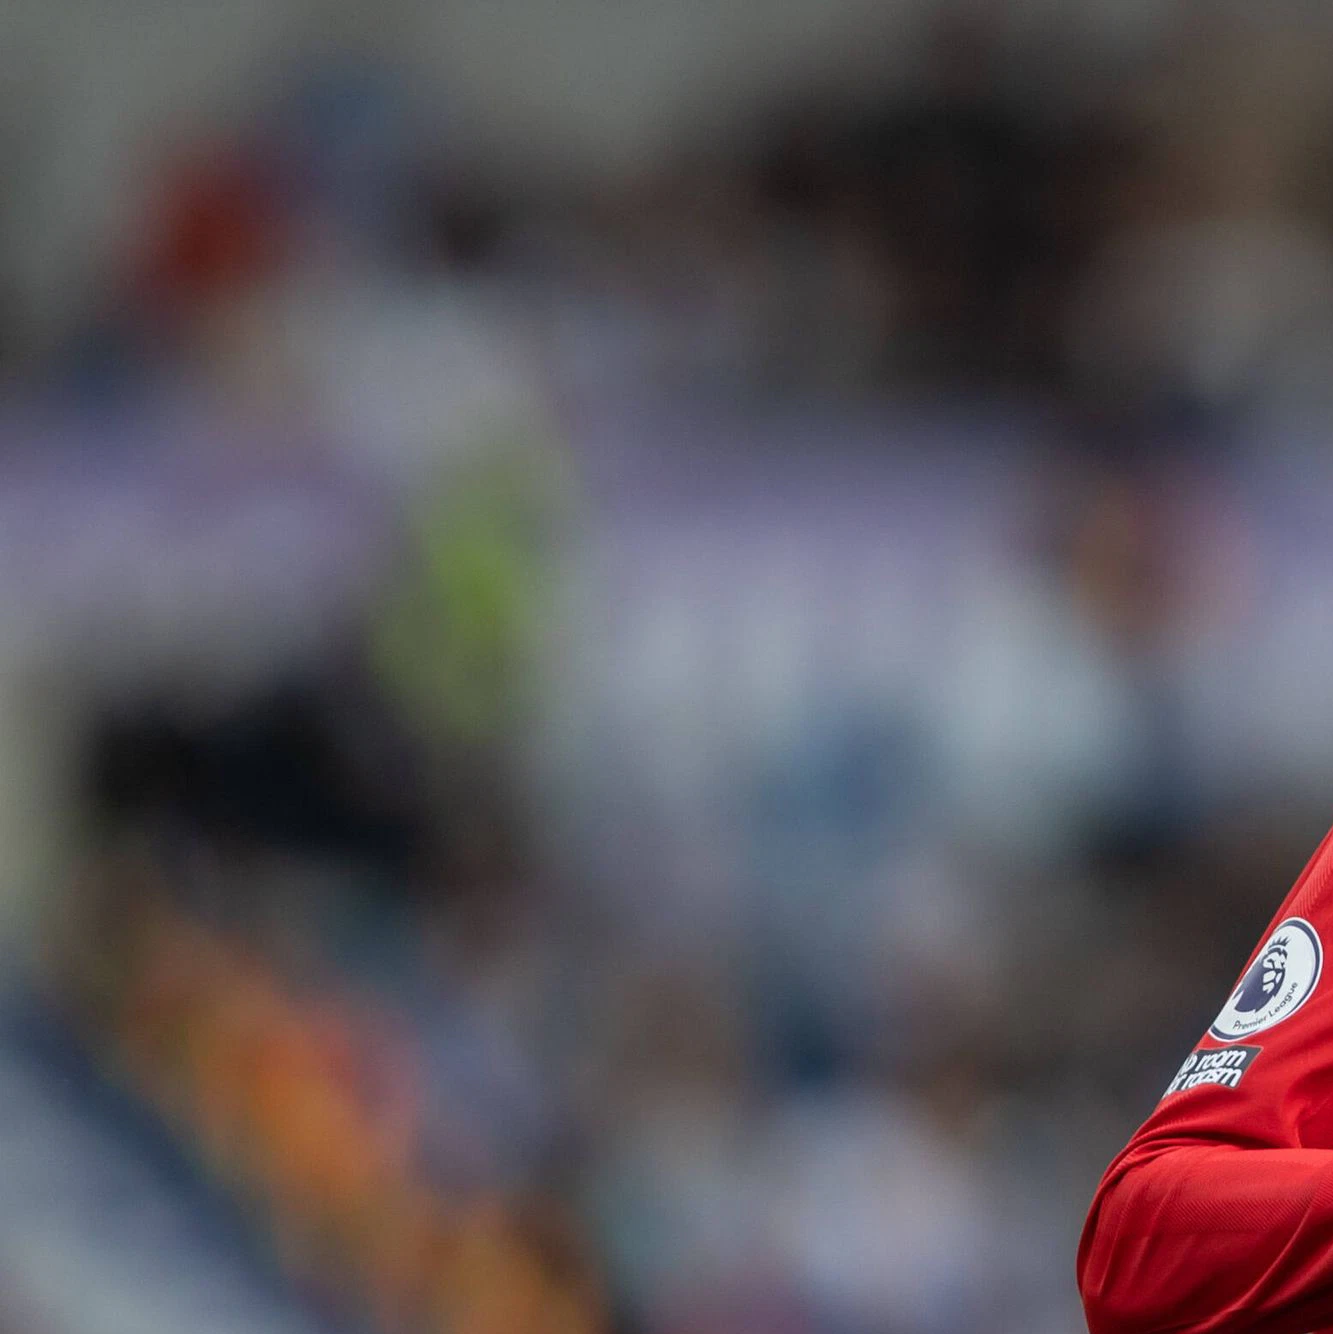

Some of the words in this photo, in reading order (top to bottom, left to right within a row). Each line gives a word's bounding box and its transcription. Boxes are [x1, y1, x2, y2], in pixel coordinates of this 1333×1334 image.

[1233, 1016, 1267, 1030] Premier
[1269, 982, 1298, 1017] League
[1195, 1050, 1247, 1072] room
